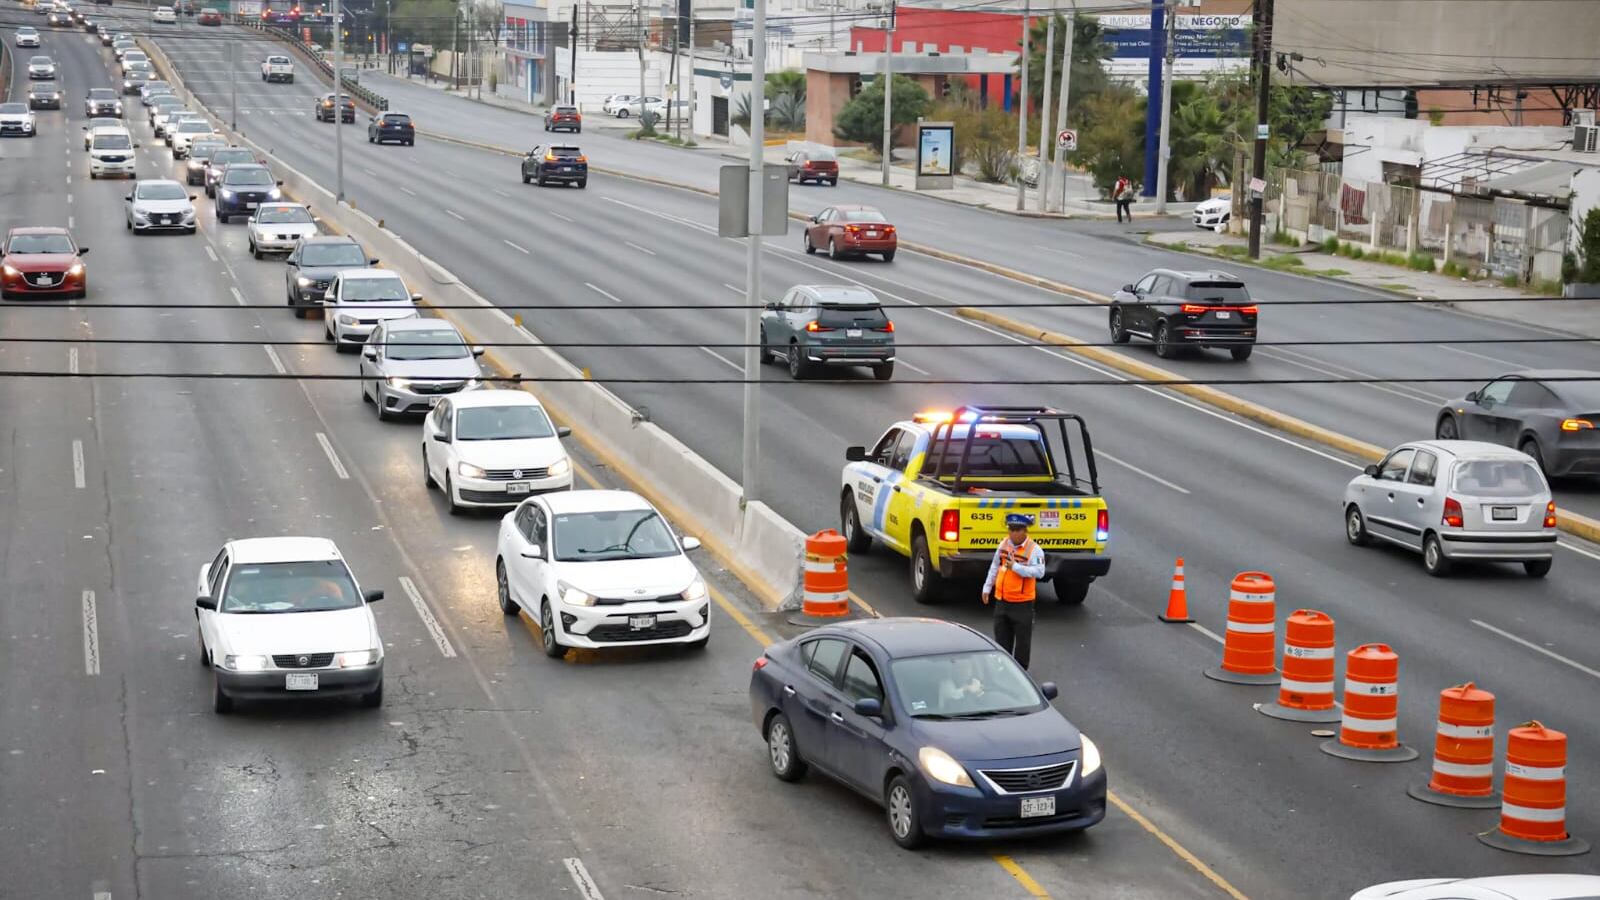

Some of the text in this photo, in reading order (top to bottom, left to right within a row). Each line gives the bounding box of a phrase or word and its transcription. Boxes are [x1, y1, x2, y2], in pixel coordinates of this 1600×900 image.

[1191, 16, 1240, 26] NEGOCIO
[970, 513, 994, 521] 635
[1064, 513, 1087, 521] 635
